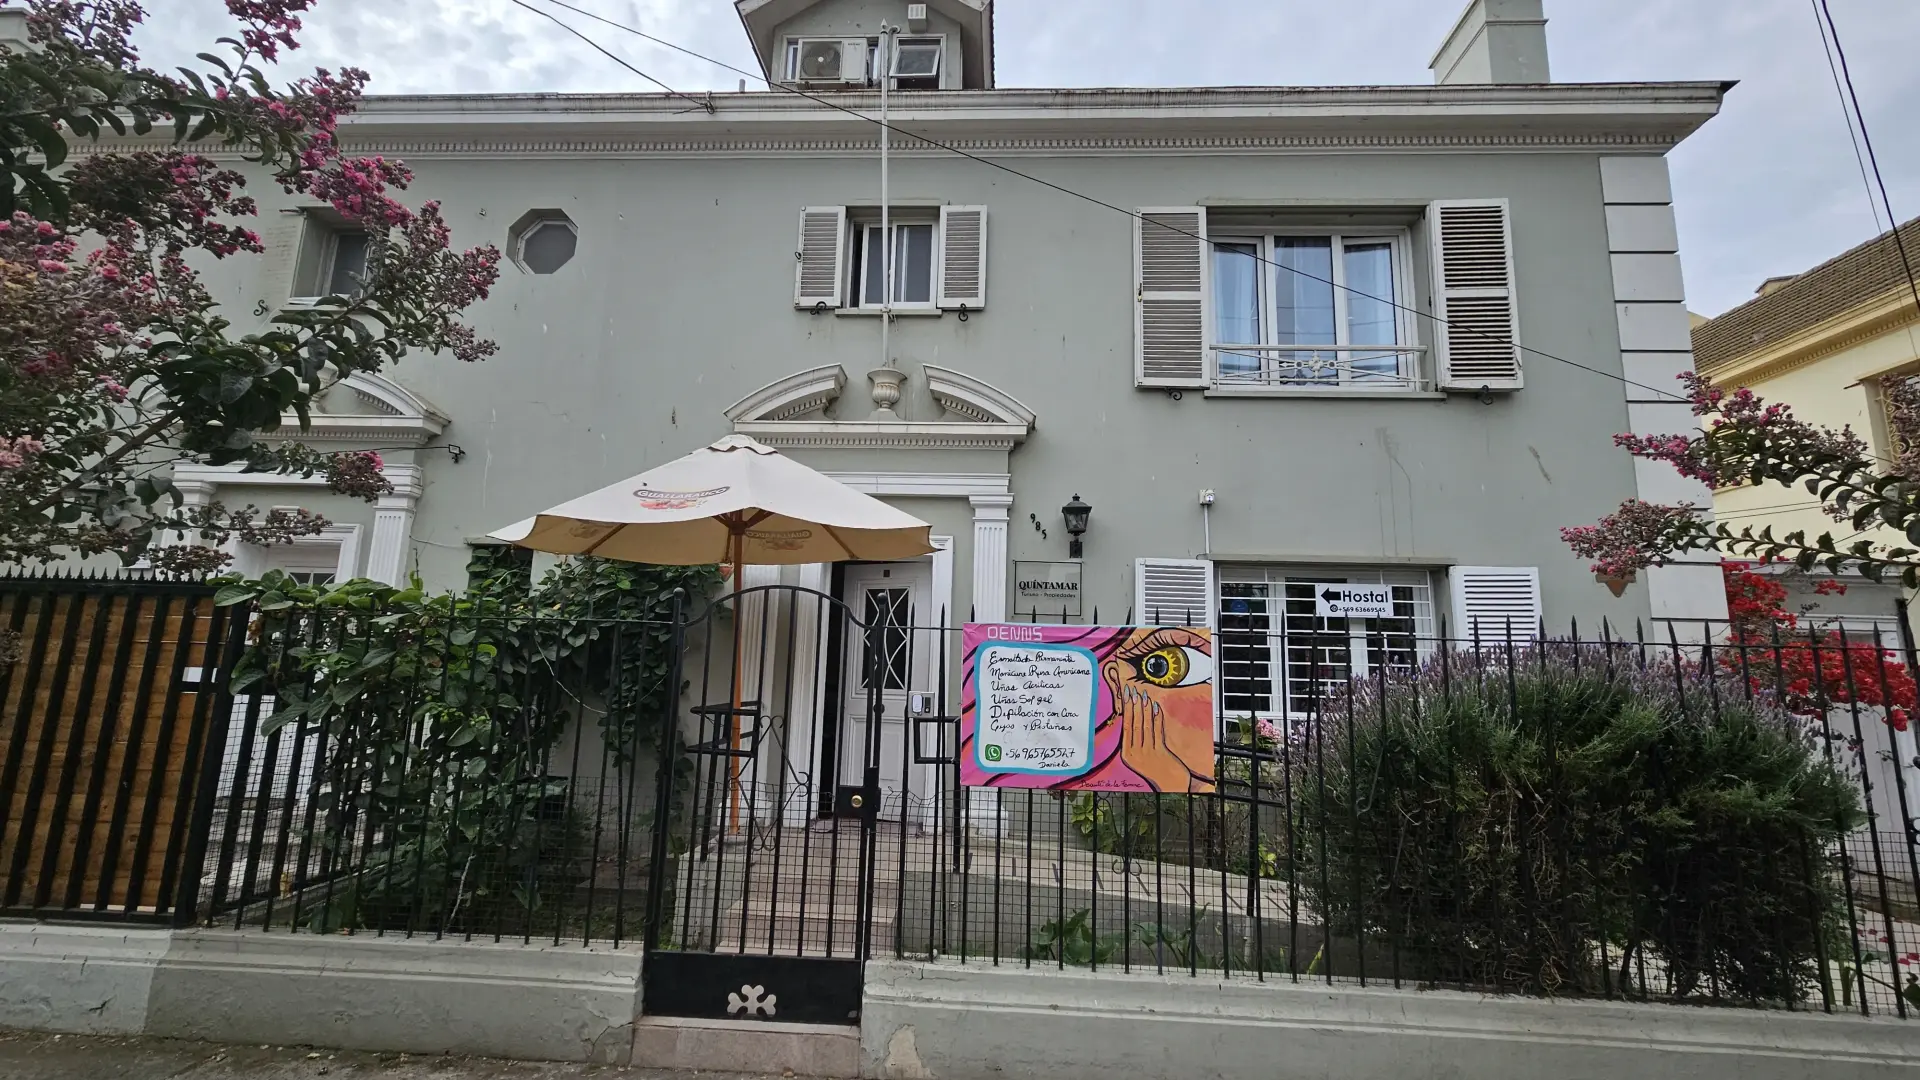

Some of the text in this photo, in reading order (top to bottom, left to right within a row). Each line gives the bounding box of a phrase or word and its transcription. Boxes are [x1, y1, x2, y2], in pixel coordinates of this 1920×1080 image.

[1030, 513, 1047, 539] 985
[1342, 590, 1388, 603] Hostal
[991, 681, 1018, 692] Uñas
[991, 693, 1017, 705] Uñas
[1036, 694, 1053, 705] gel
[1038, 760, 1070, 769] Daniela
